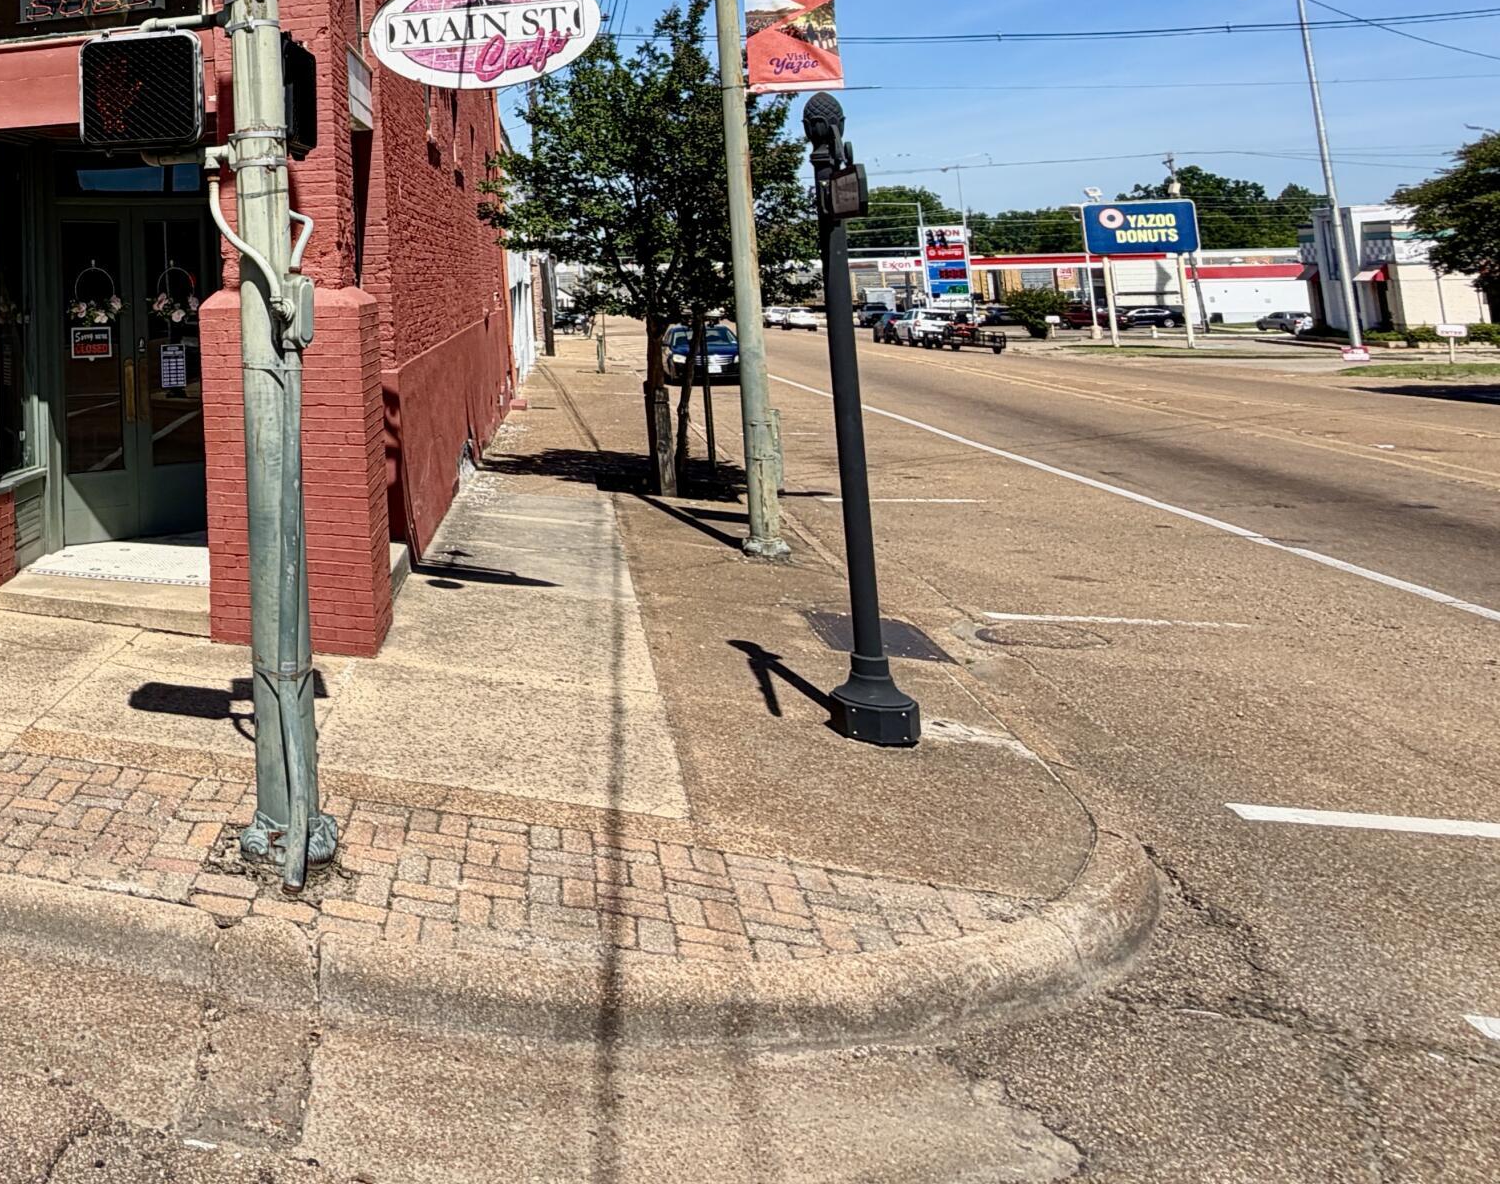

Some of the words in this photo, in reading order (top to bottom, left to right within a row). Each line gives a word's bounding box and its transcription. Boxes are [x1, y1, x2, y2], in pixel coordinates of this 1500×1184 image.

[404, 11, 509, 45] MAIN
[786, 52, 811, 62] Visit
[769, 57, 819, 74] Yazoo
[1126, 213, 1177, 228] YAZOO
[1115, 228, 1179, 244] DONUTS
[75, 343, 108, 354] CLOSED
